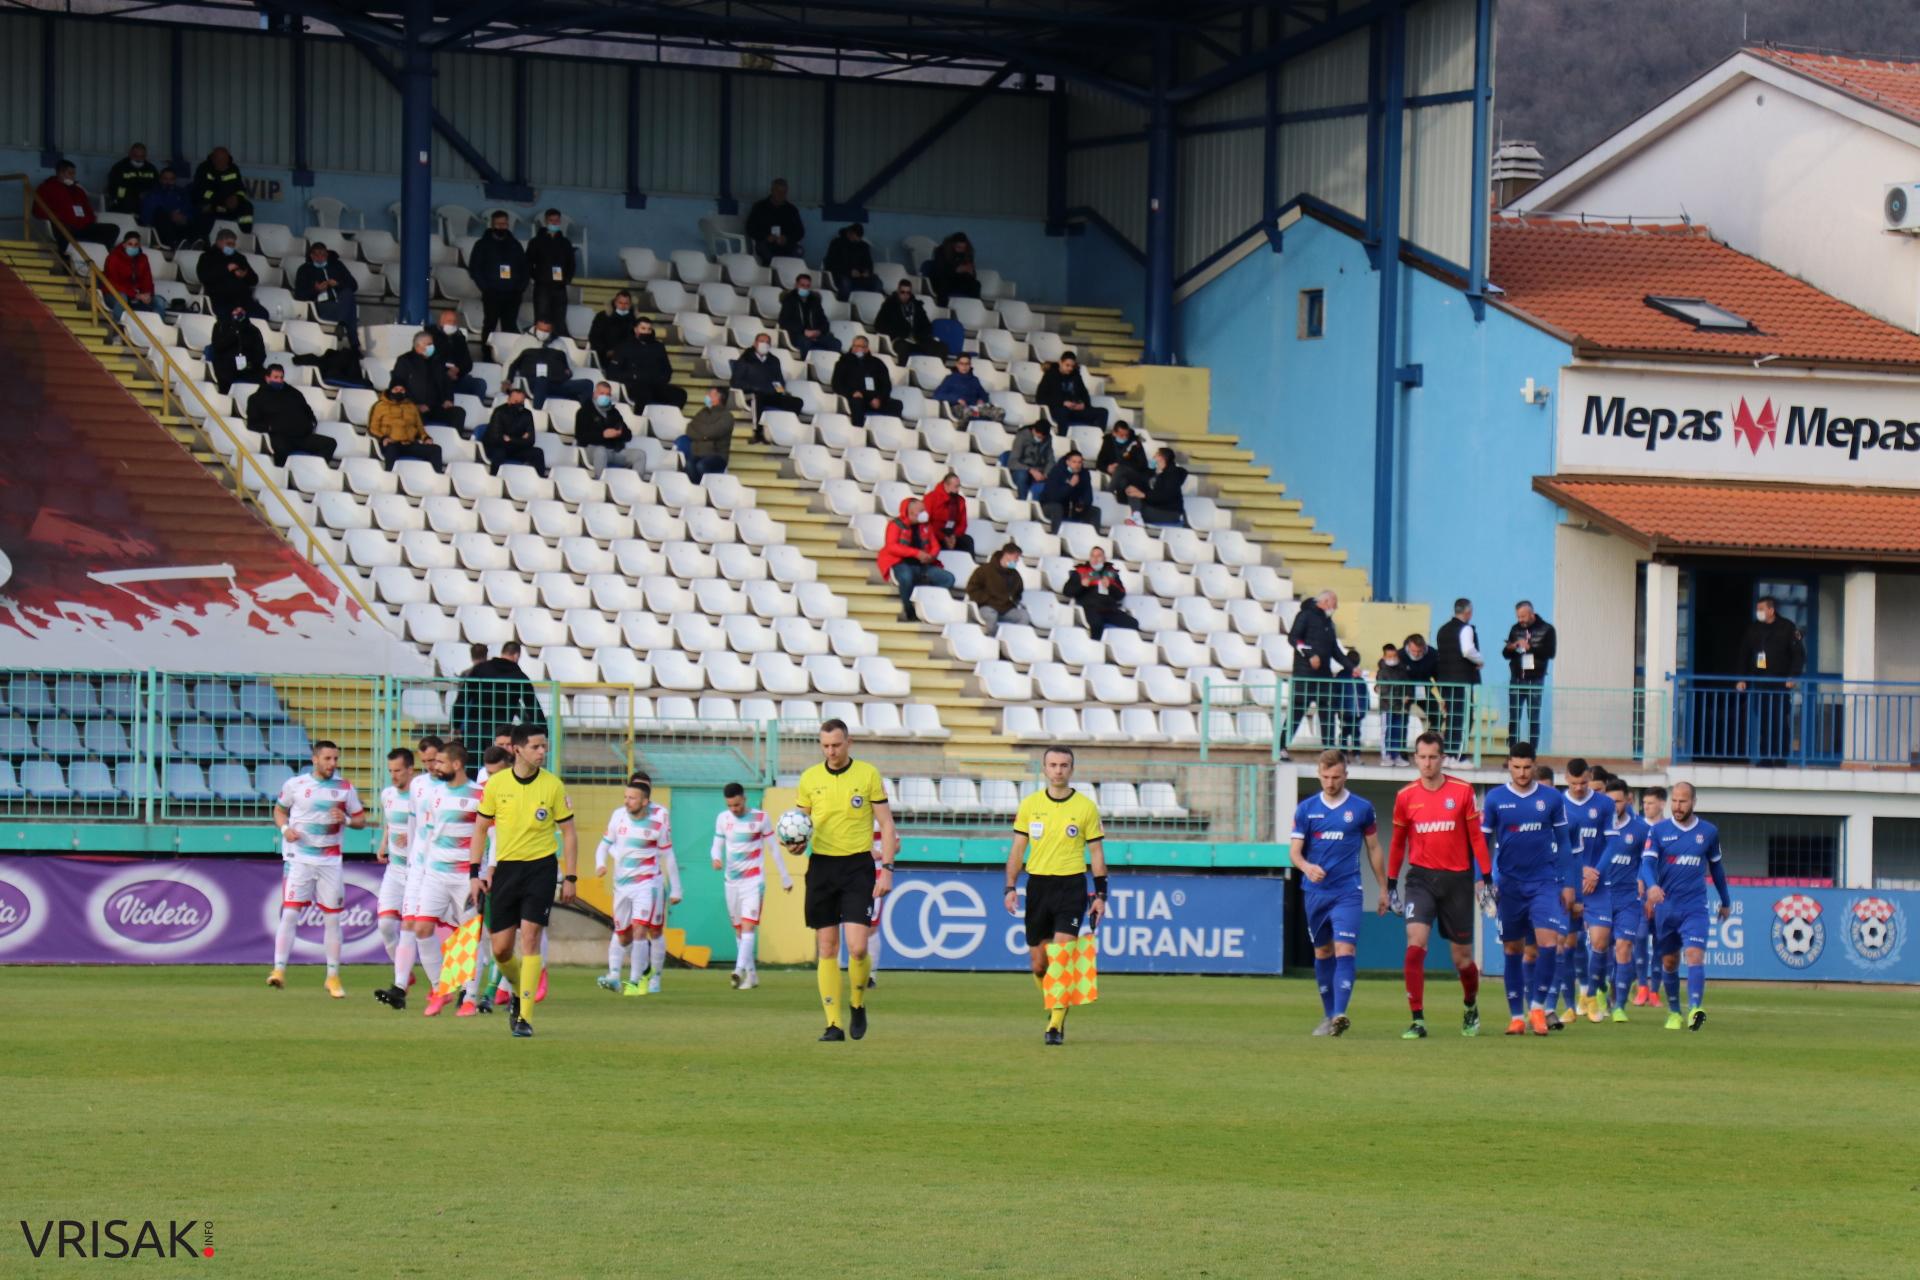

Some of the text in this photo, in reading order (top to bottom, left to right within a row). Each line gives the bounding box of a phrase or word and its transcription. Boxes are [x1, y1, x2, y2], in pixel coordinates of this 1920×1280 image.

[243, 178, 281, 200] VIP
[1582, 395, 1723, 451] Mepas
[1784, 405, 1920, 460] Mepas
[116, 894, 200, 926] Violeta
[1713, 953, 1744, 967] KLUB
